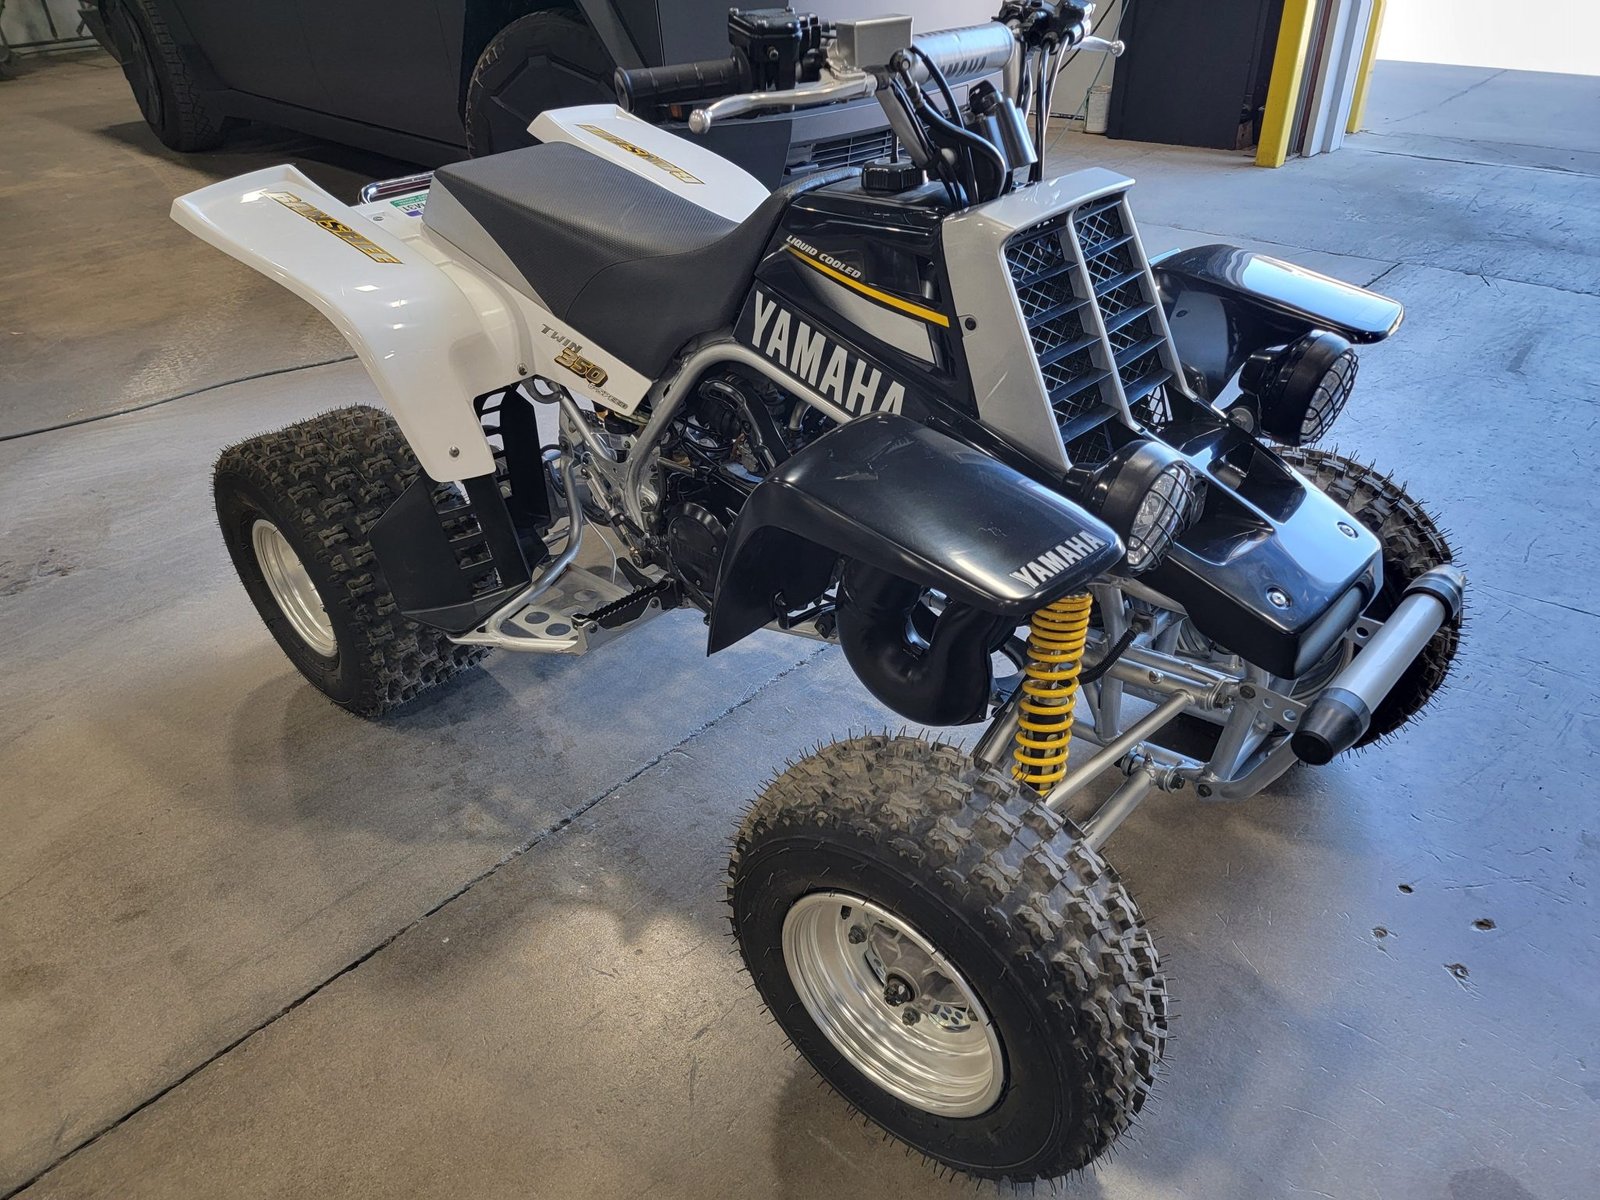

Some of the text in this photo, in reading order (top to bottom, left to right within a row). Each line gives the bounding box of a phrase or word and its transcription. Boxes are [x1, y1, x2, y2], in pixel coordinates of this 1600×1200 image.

[938, 55, 987, 78] MAHA
[786, 235, 862, 278] LIQUID COOLED
[541, 323, 583, 354] TWIN
[752, 290, 905, 416] YAMAHA
[554, 347, 608, 388] 350
[1009, 530, 1106, 589] YAMAHA
